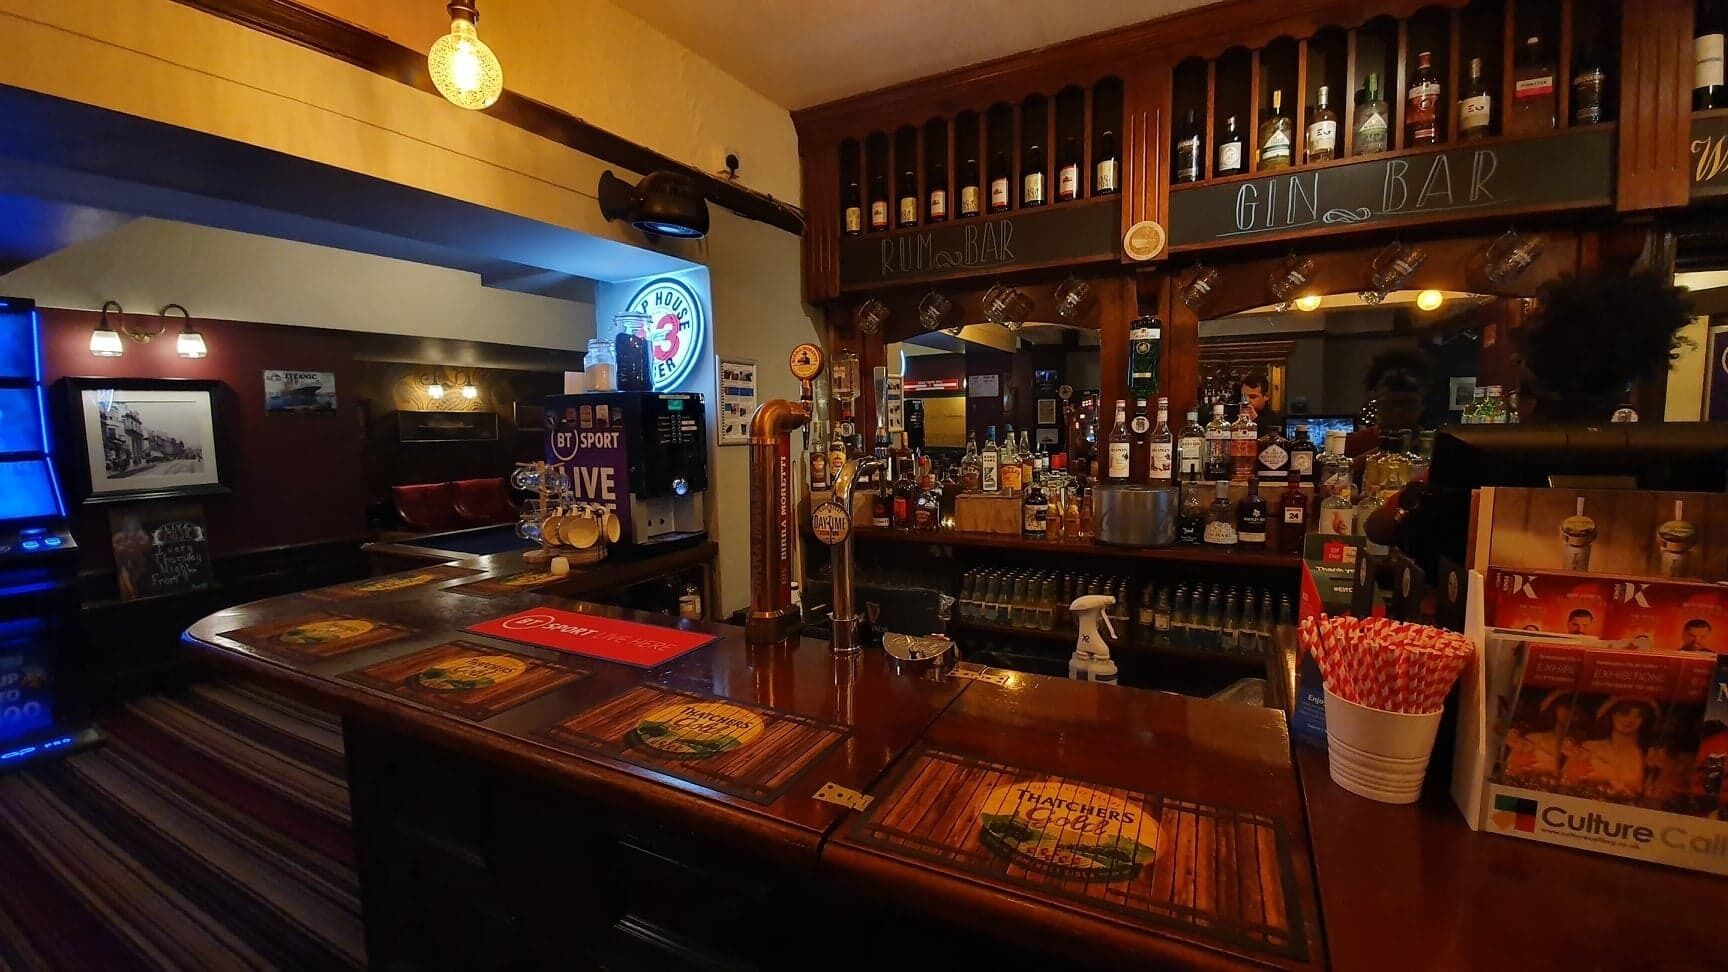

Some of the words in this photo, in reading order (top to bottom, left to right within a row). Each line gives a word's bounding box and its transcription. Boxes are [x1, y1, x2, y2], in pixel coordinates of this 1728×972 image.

[1236, 172, 1319, 231] GIN
[1382, 149, 1498, 213] BAR
[880, 231, 934, 276] RUM
[964, 219, 1016, 265] BAR
[655, 291, 691, 332] HOUSE
[555, 432, 573, 449] BT
[579, 431, 621, 450] SPORT
[1288, 512, 1299, 520] 24
[518, 617, 543, 627] BT
[541, 621, 599, 637] SPORT
[593, 630, 628, 643] LIVE
[628, 636, 679, 652] HERE
[1307, 694, 1325, 705] Enjo
[681, 706, 754, 730] THATCHERS
[1017, 789, 1136, 824] THATCHERS
[1024, 806, 1110, 836] Gold
[1541, 806, 1654, 843] Culture
[1660, 826, 1728, 857] Call
